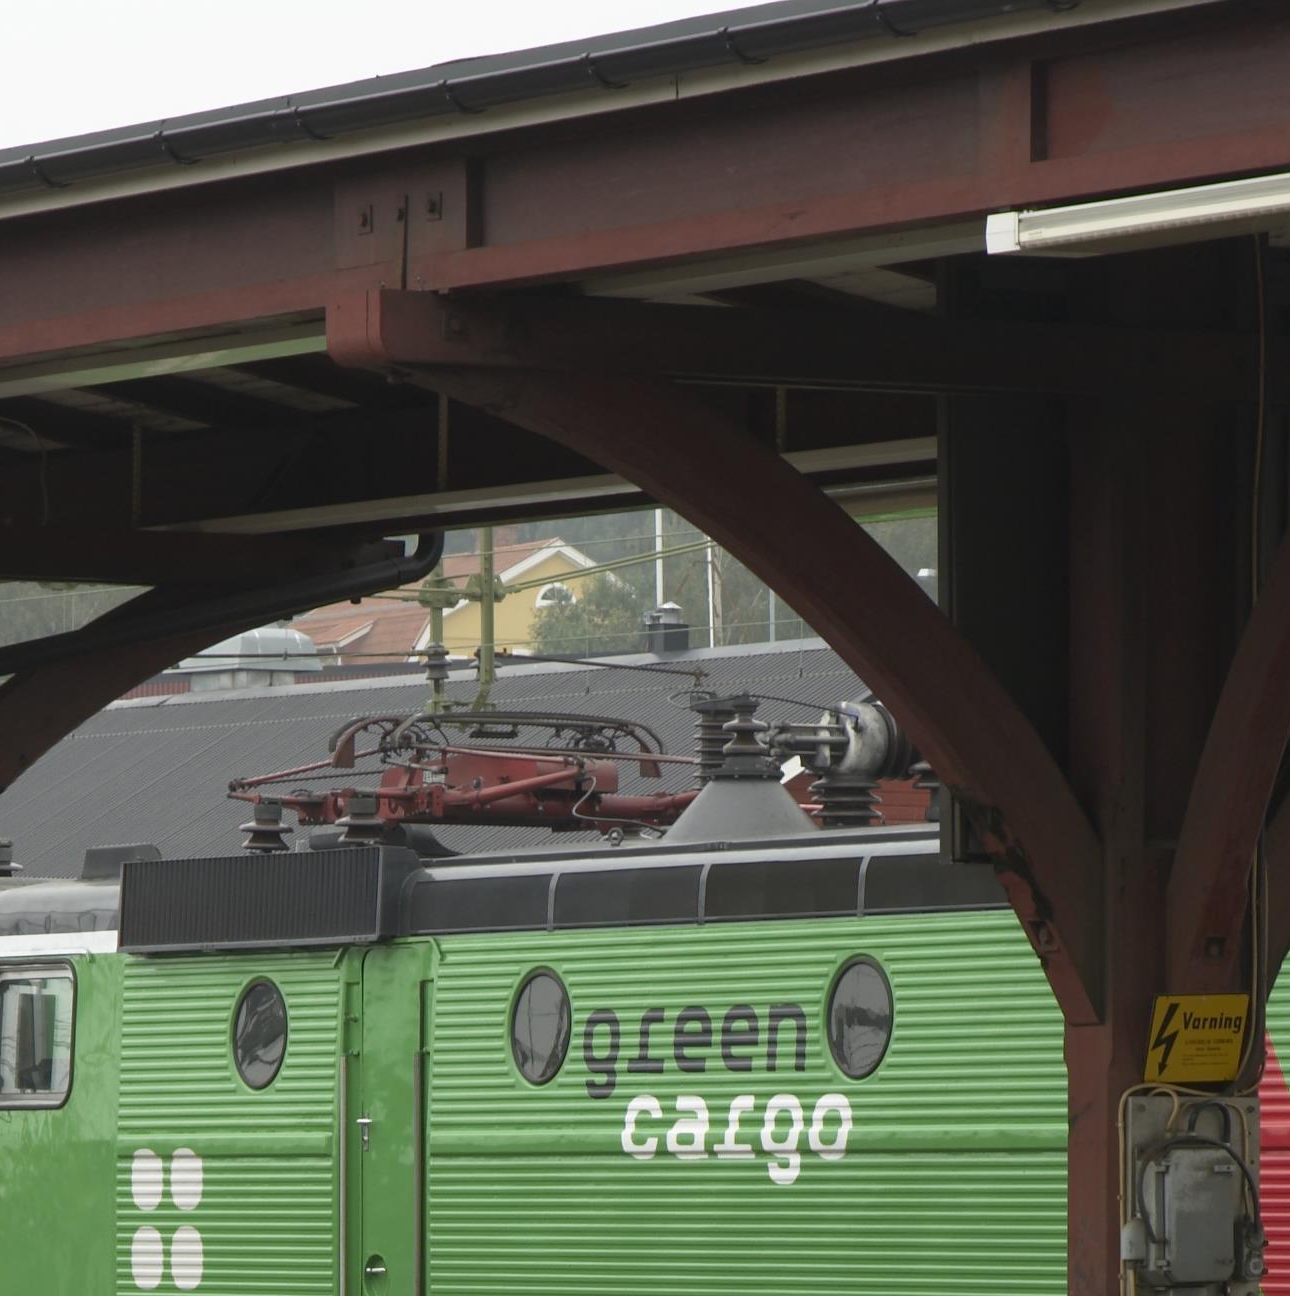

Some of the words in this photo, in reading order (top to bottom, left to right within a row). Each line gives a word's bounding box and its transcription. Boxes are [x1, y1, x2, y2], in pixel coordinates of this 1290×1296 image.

[583, 1002, 808, 1100] green
[1183, 1012, 1242, 1034] Varning
[621, 1093, 854, 1185] cargo
